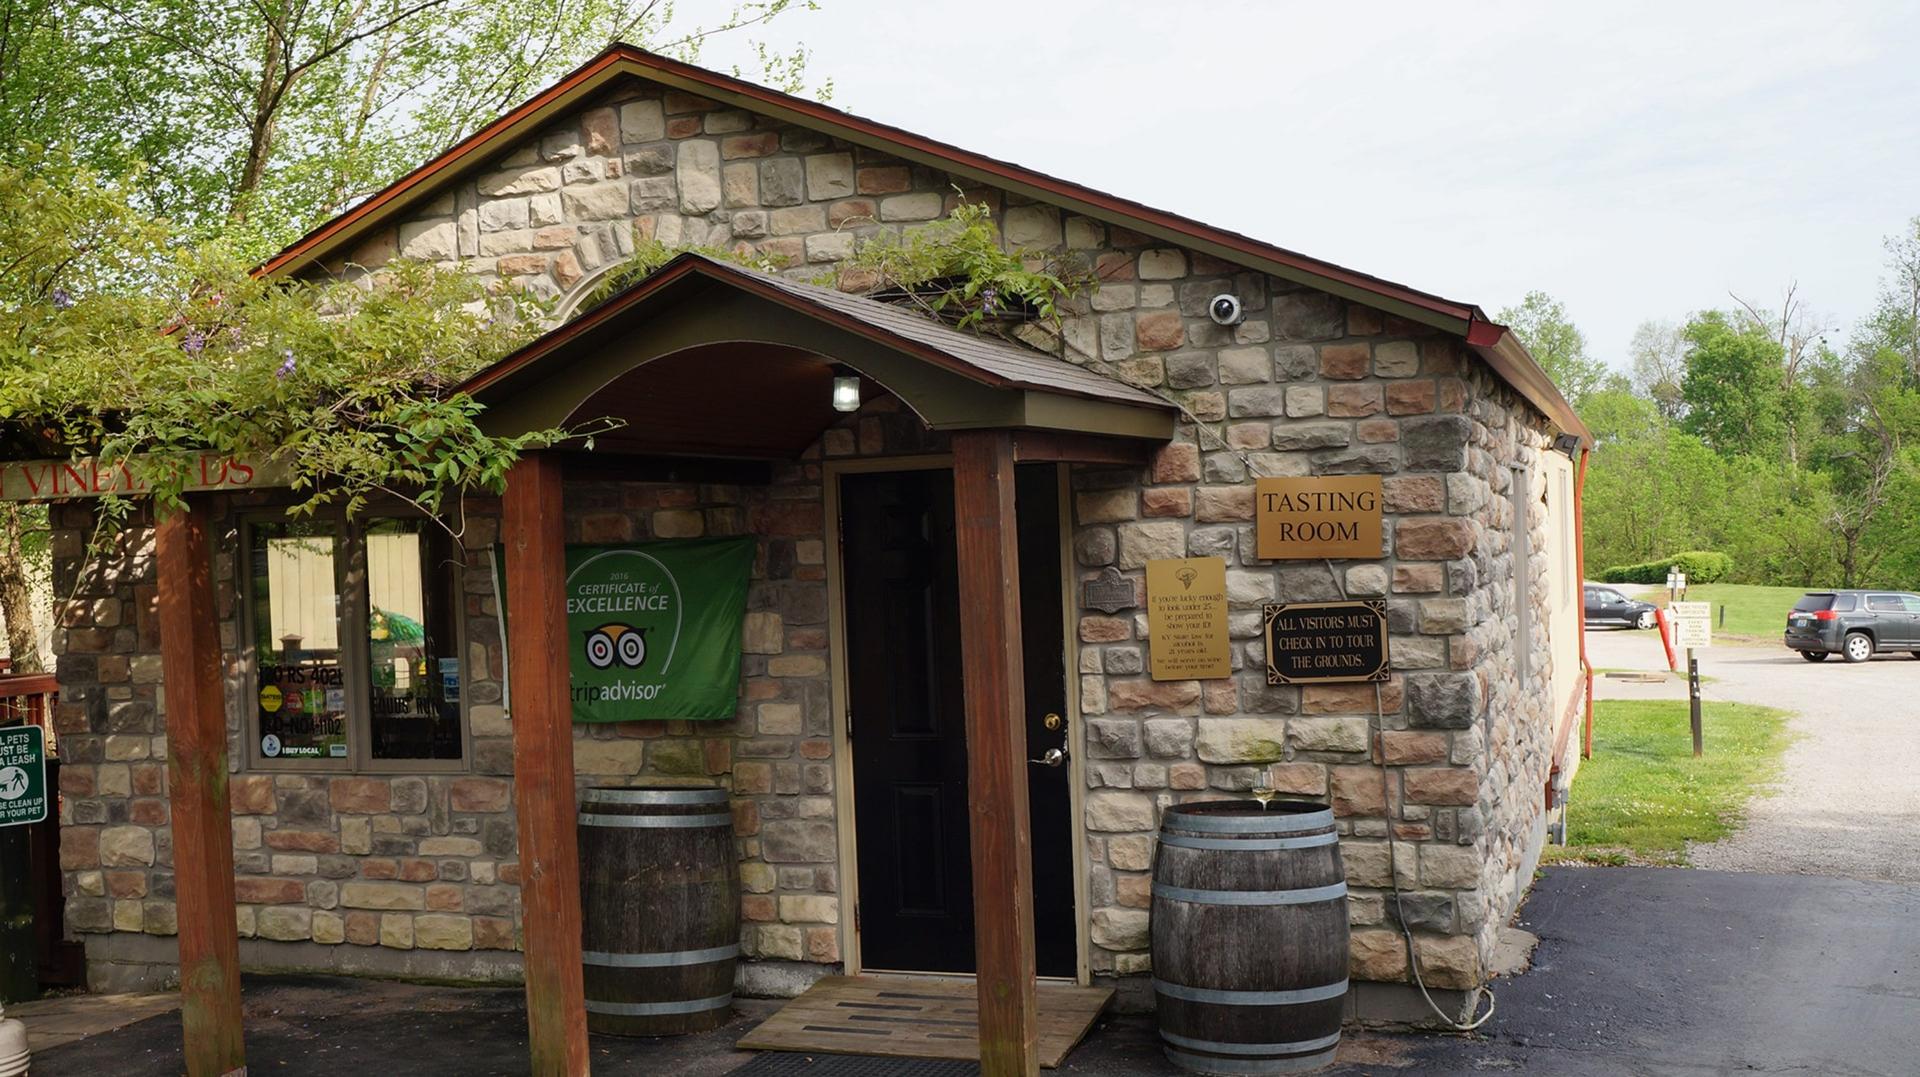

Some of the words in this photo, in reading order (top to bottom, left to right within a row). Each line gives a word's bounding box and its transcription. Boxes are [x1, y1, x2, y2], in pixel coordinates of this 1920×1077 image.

[22, 454, 254, 495] VINEYDS
[1262, 491, 1375, 512] TASTING
[1280, 521, 1359, 541] ROOM
[578, 582, 646, 595] CERTIFICATE
[649, 582, 660, 594] of
[566, 595, 669, 613] EXCELLENCE
[1199, 593, 1223, 602] enough
[1175, 612, 1204, 622] prepared
[1276, 619, 1297, 631] ALL
[1299, 616, 1345, 630] VISITORS
[1347, 615, 1375, 628] MUST
[1185, 622, 1201, 630] your
[1279, 636, 1313, 650] CHECK
[1315, 636, 1326, 649] IN
[1329, 635, 1343, 649] TO
[1346, 634, 1374, 648] TOUR
[1291, 655, 1312, 669] THE
[1314, 653, 1365, 668] GROUNDS.
[570, 680, 662, 706] tripadvisor
[7, 734, 30, 745] PETS
[0, 746, 14, 756] UST
[17, 745, 28, 754] BE
[0, 757, 5, 767] A
[7, 754, 36, 766] LEASH
[8, 799, 31, 808] CLEAN
[33, 797, 43, 806] UP
[6, 808, 26, 817] YOUR
[28, 806, 41, 815] PET
